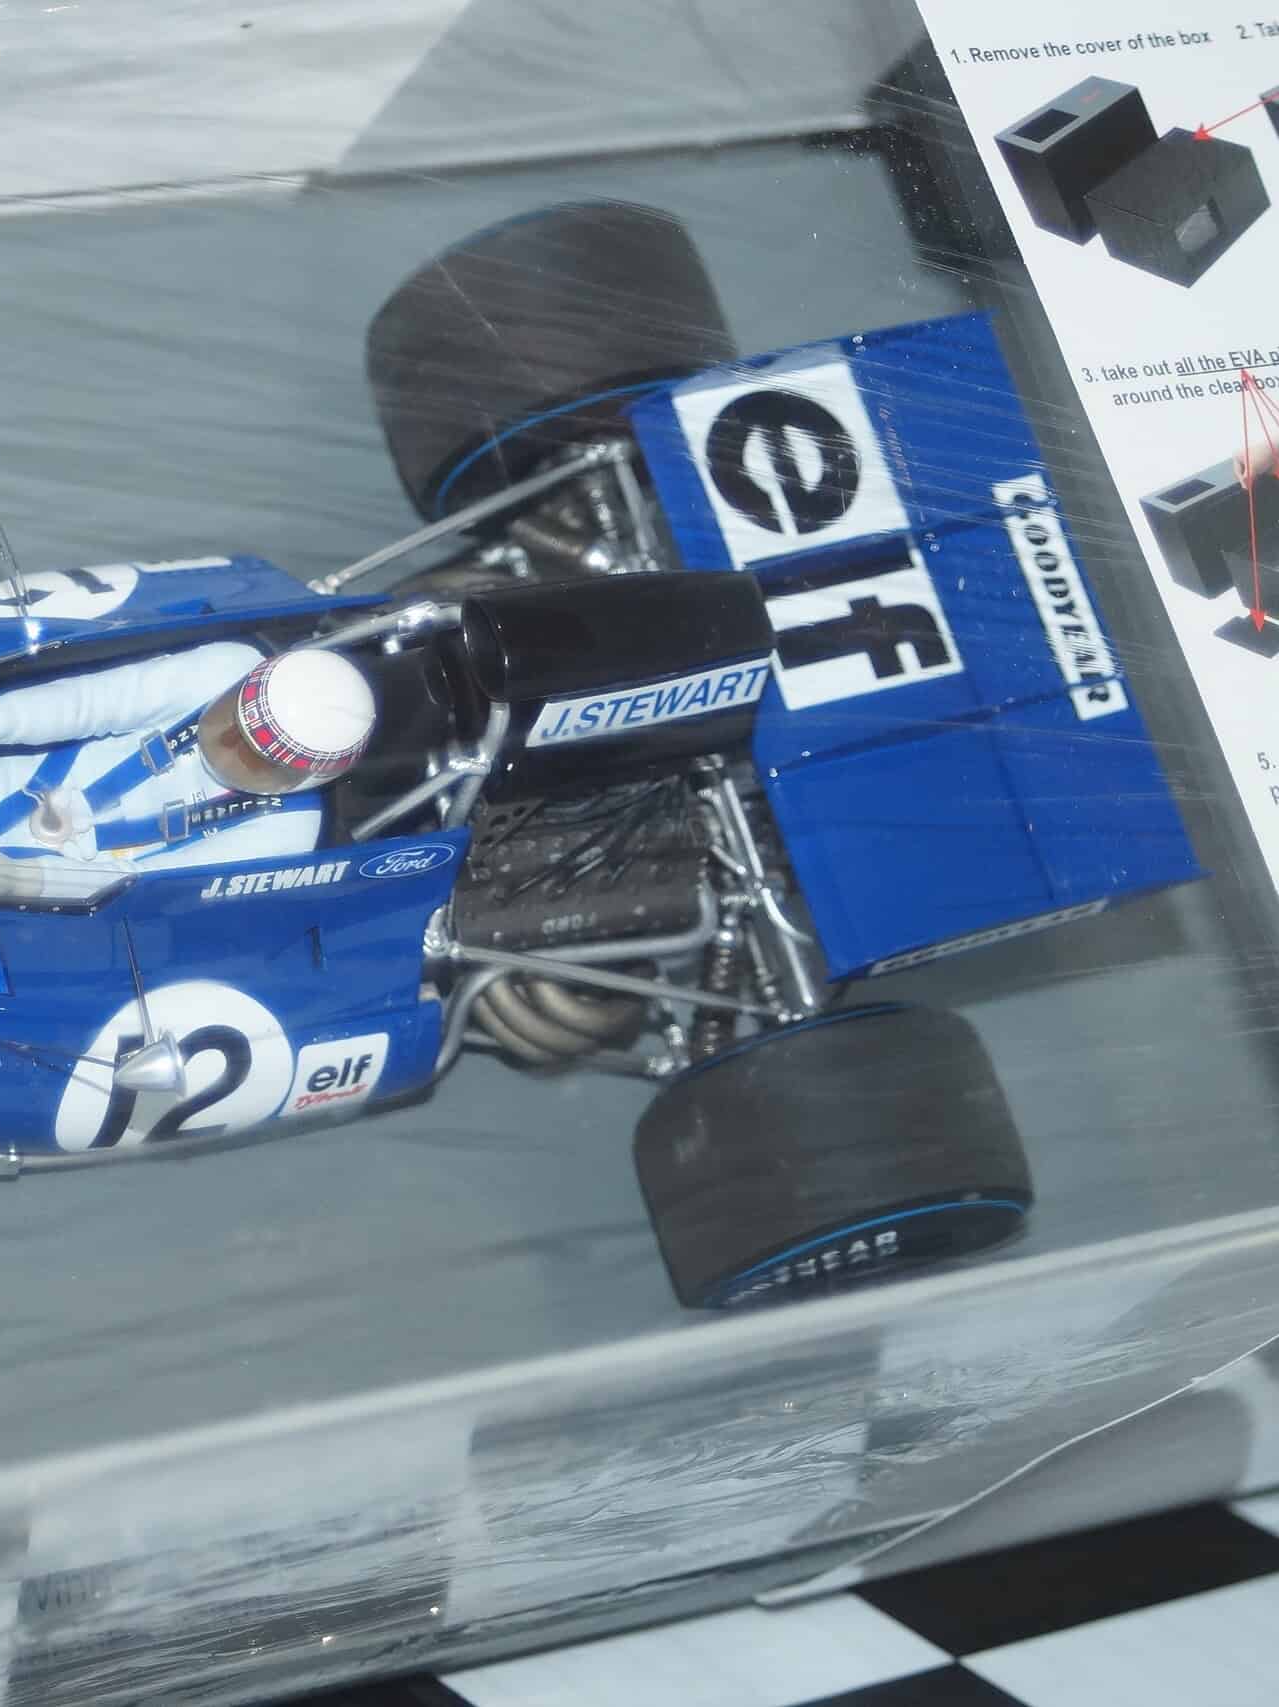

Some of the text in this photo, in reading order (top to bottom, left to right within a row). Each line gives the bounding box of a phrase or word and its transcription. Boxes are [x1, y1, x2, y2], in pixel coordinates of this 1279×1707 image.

[950, 31, 1210, 64] 1. Remove the cover of the box
[1081, 366, 1099, 383] 3.
[1101, 364, 1138, 382] take
[1143, 360, 1172, 376] out
[1174, 356, 1196, 374] all
[1198, 354, 1226, 371] the
[1228, 349, 1267, 367] EVA
[1112, 385, 1173, 406] around
[1176, 381, 1205, 399] the
[1208, 377, 1249, 395] clear
[703, 389, 954, 683] elf
[541, 665, 770, 740] J.STEWART
[1257, 752, 1277, 770] 5.
[200, 860, 352, 900] J.STEWART
[307, 1053, 374, 1093] elf
